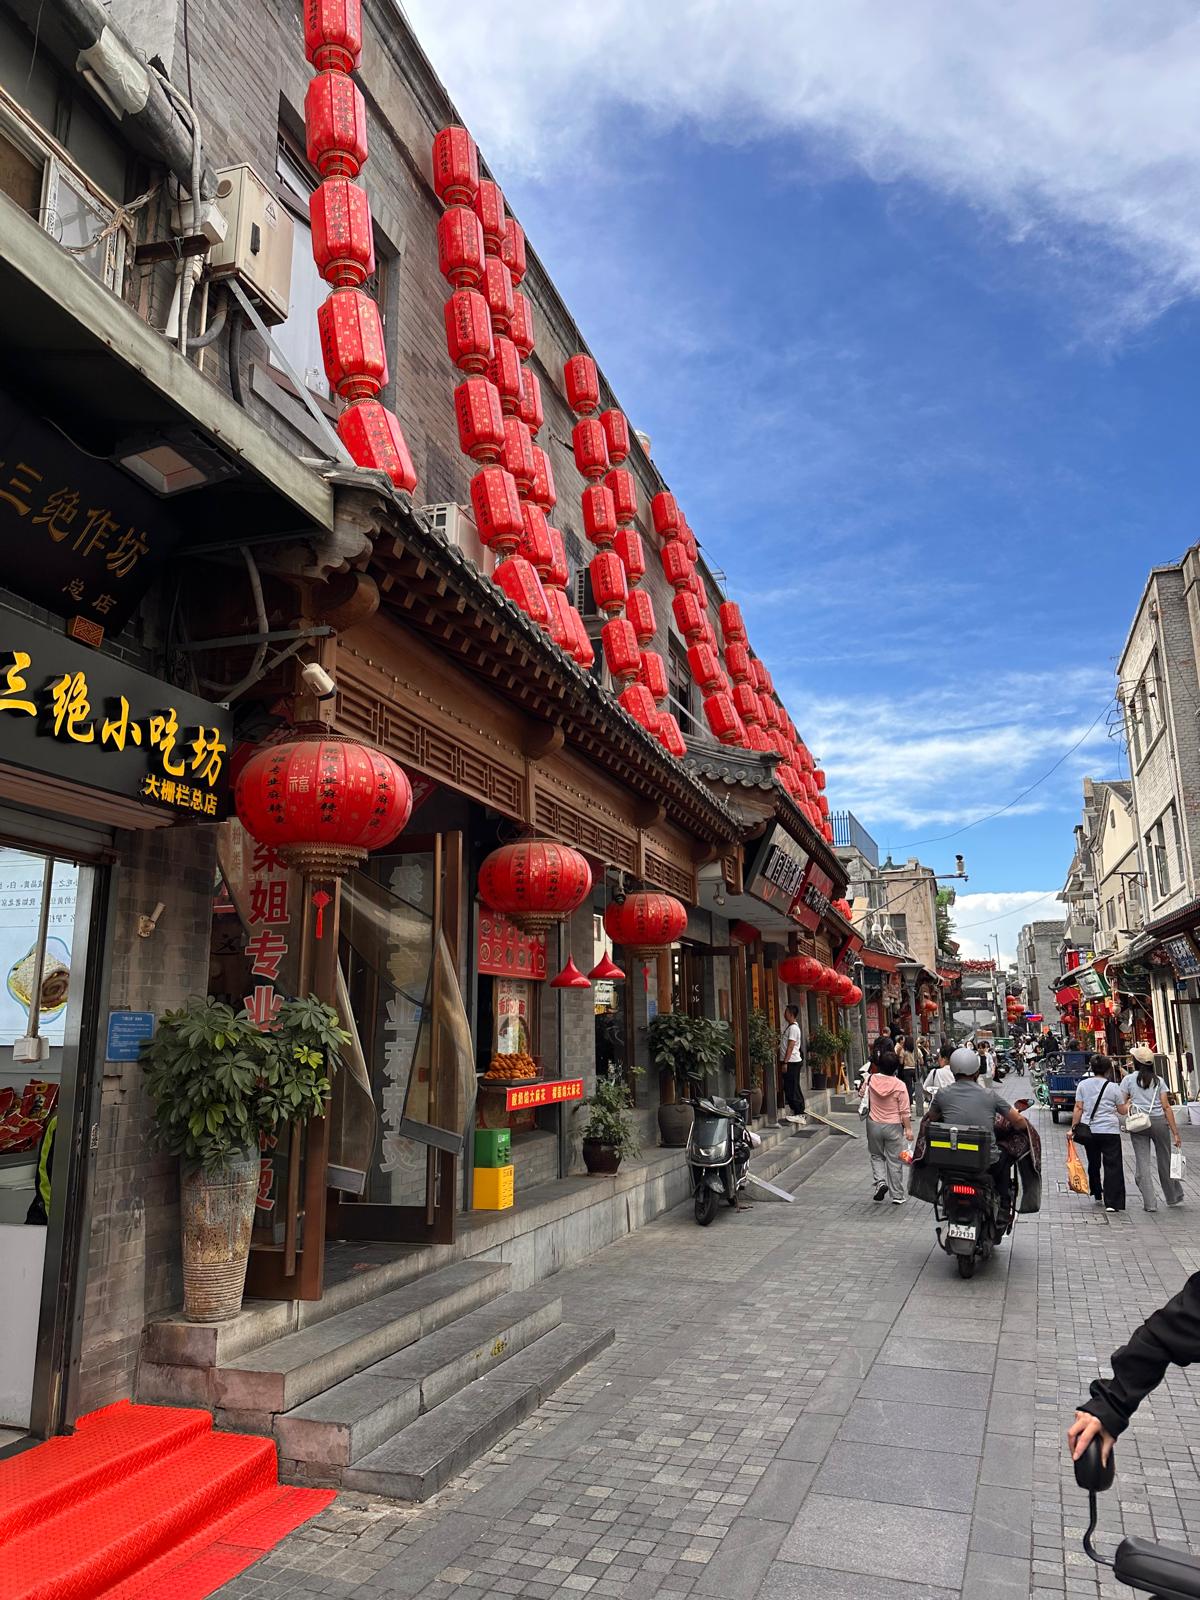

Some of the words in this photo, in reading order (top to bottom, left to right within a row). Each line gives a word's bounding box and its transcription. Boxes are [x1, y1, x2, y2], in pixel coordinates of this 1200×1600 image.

[0, 461, 150, 578] 三绝作坊
[62, 578, 118, 615] 总店
[0, 651, 227, 787] 三绝小吃坊
[144, 774, 218, 815] 大栅栏总店
